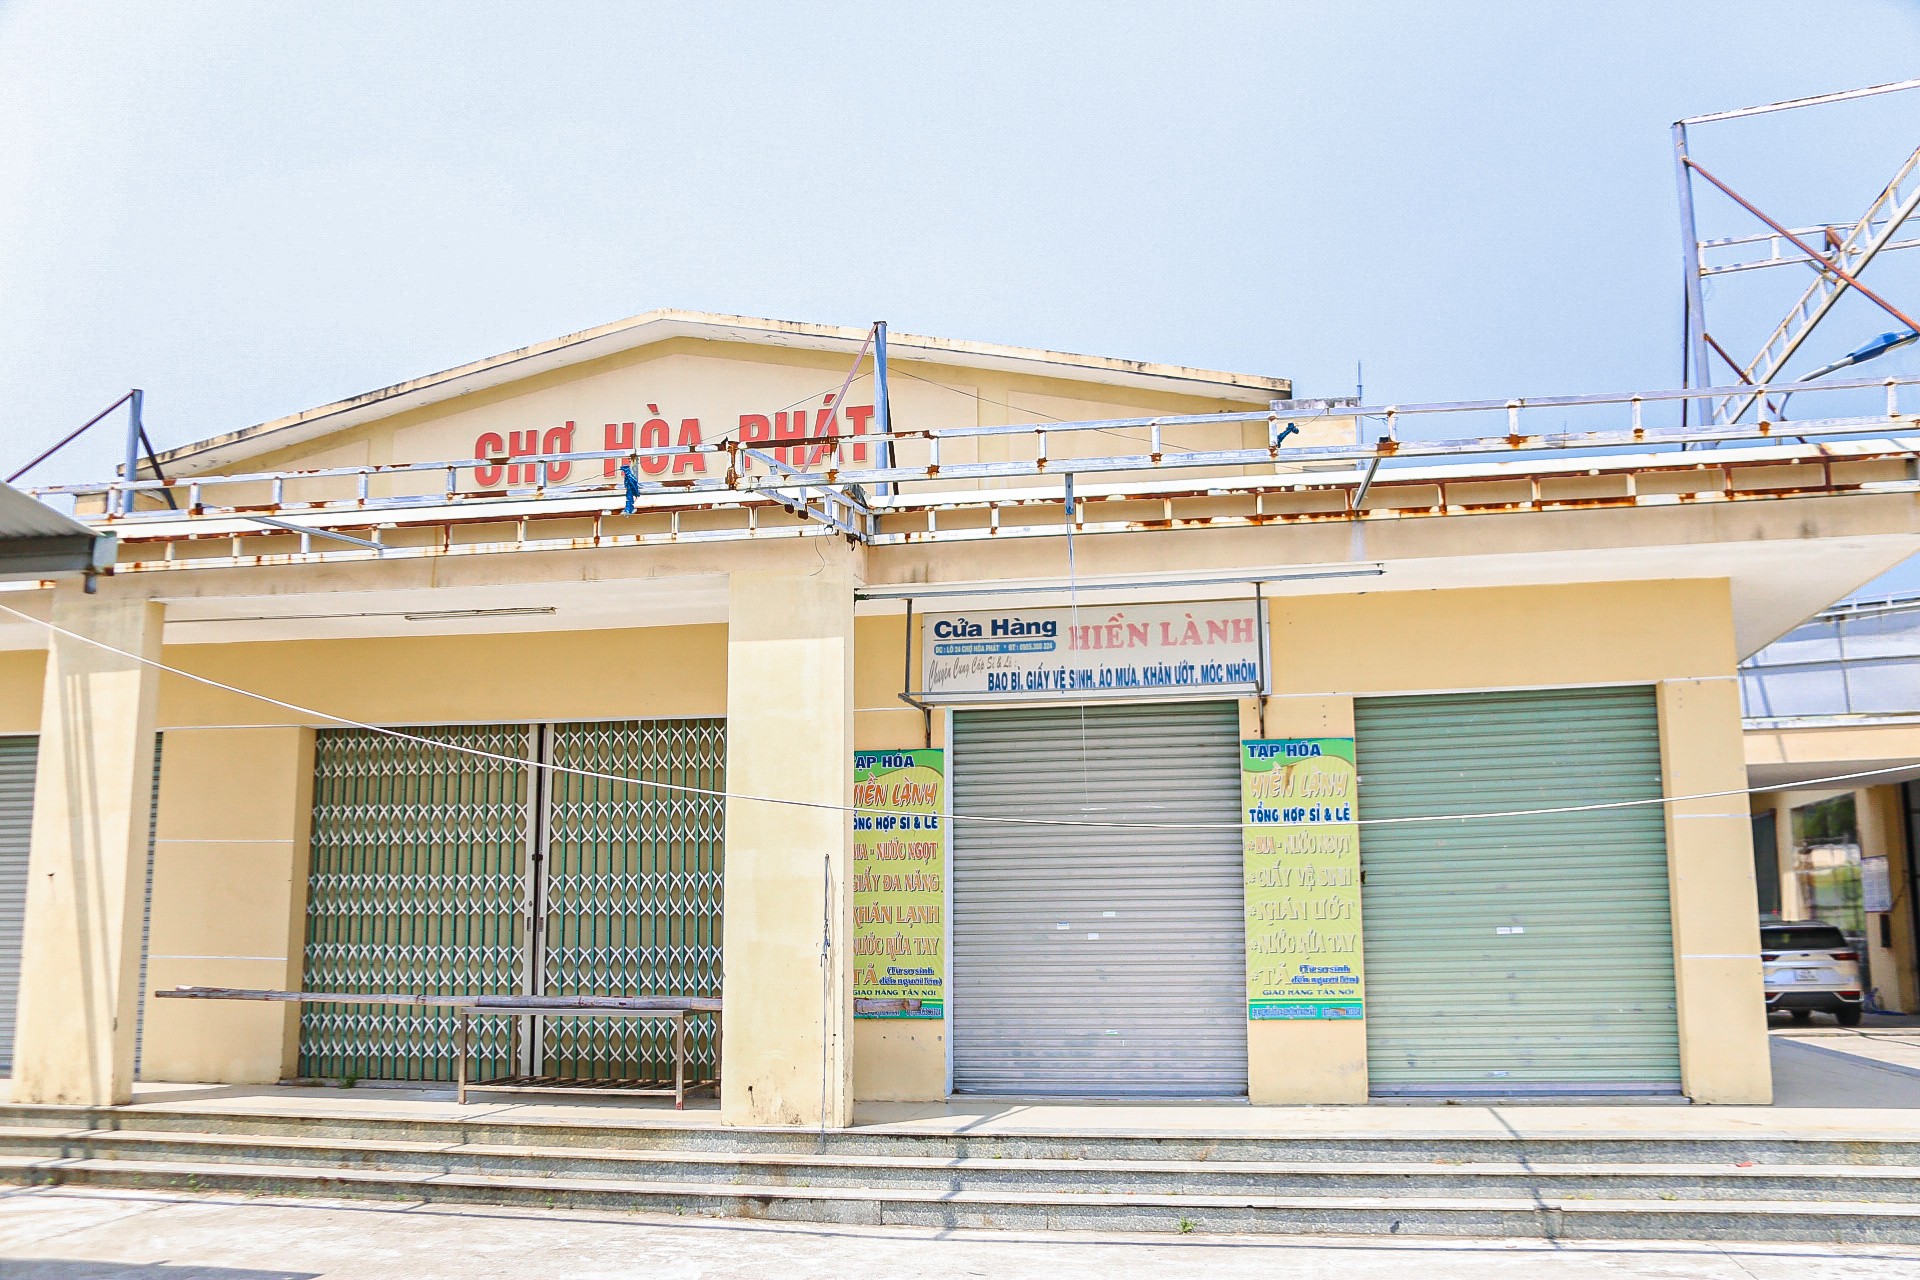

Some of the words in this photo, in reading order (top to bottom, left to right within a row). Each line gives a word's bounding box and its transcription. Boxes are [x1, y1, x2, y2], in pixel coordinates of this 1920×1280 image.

[474, 420, 576, 487] CHỢ
[603, 403, 707, 476] HÒA
[738, 393, 874, 470] PHÁT
[934, 617, 983, 639] Cửa
[990, 617, 1058, 638] Hàng
[1068, 612, 1150, 651] HIỀN
[1159, 612, 1254, 647] LÀNH
[987, 671, 1008, 691] BAO
[1026, 662, 1050, 689] GIẤY
[1052, 665, 1066, 694] VỆ
[1098, 662, 1113, 688] ÁO
[1142, 661, 1172, 686] KHĂN
[1200, 658, 1223, 683] MÓC
[1225, 658, 1256, 681] NHÔM
[854, 755, 877, 771] ẠP
[1248, 745, 1280, 760] TẠP
[891, 777, 938, 806] LÀNH
[1250, 762, 1296, 799] HIỀN
[1299, 767, 1349, 798] LÀNH
[876, 815, 896, 832] HỢP
[914, 817, 922, 829] &
[1249, 801, 1279, 822] TỔNG
[1283, 807, 1305, 823] HỢP
[1324, 808, 1332, 821] &
[877, 836, 906, 861] NƯỚC
[908, 841, 938, 864] NGỌT
[1255, 836, 1276, 854] BIA
[883, 875, 902, 892] ĐA
[896, 905, 940, 928] LẠNH
[885, 931, 911, 961] RỬA
[914, 937, 940, 955] TAY
